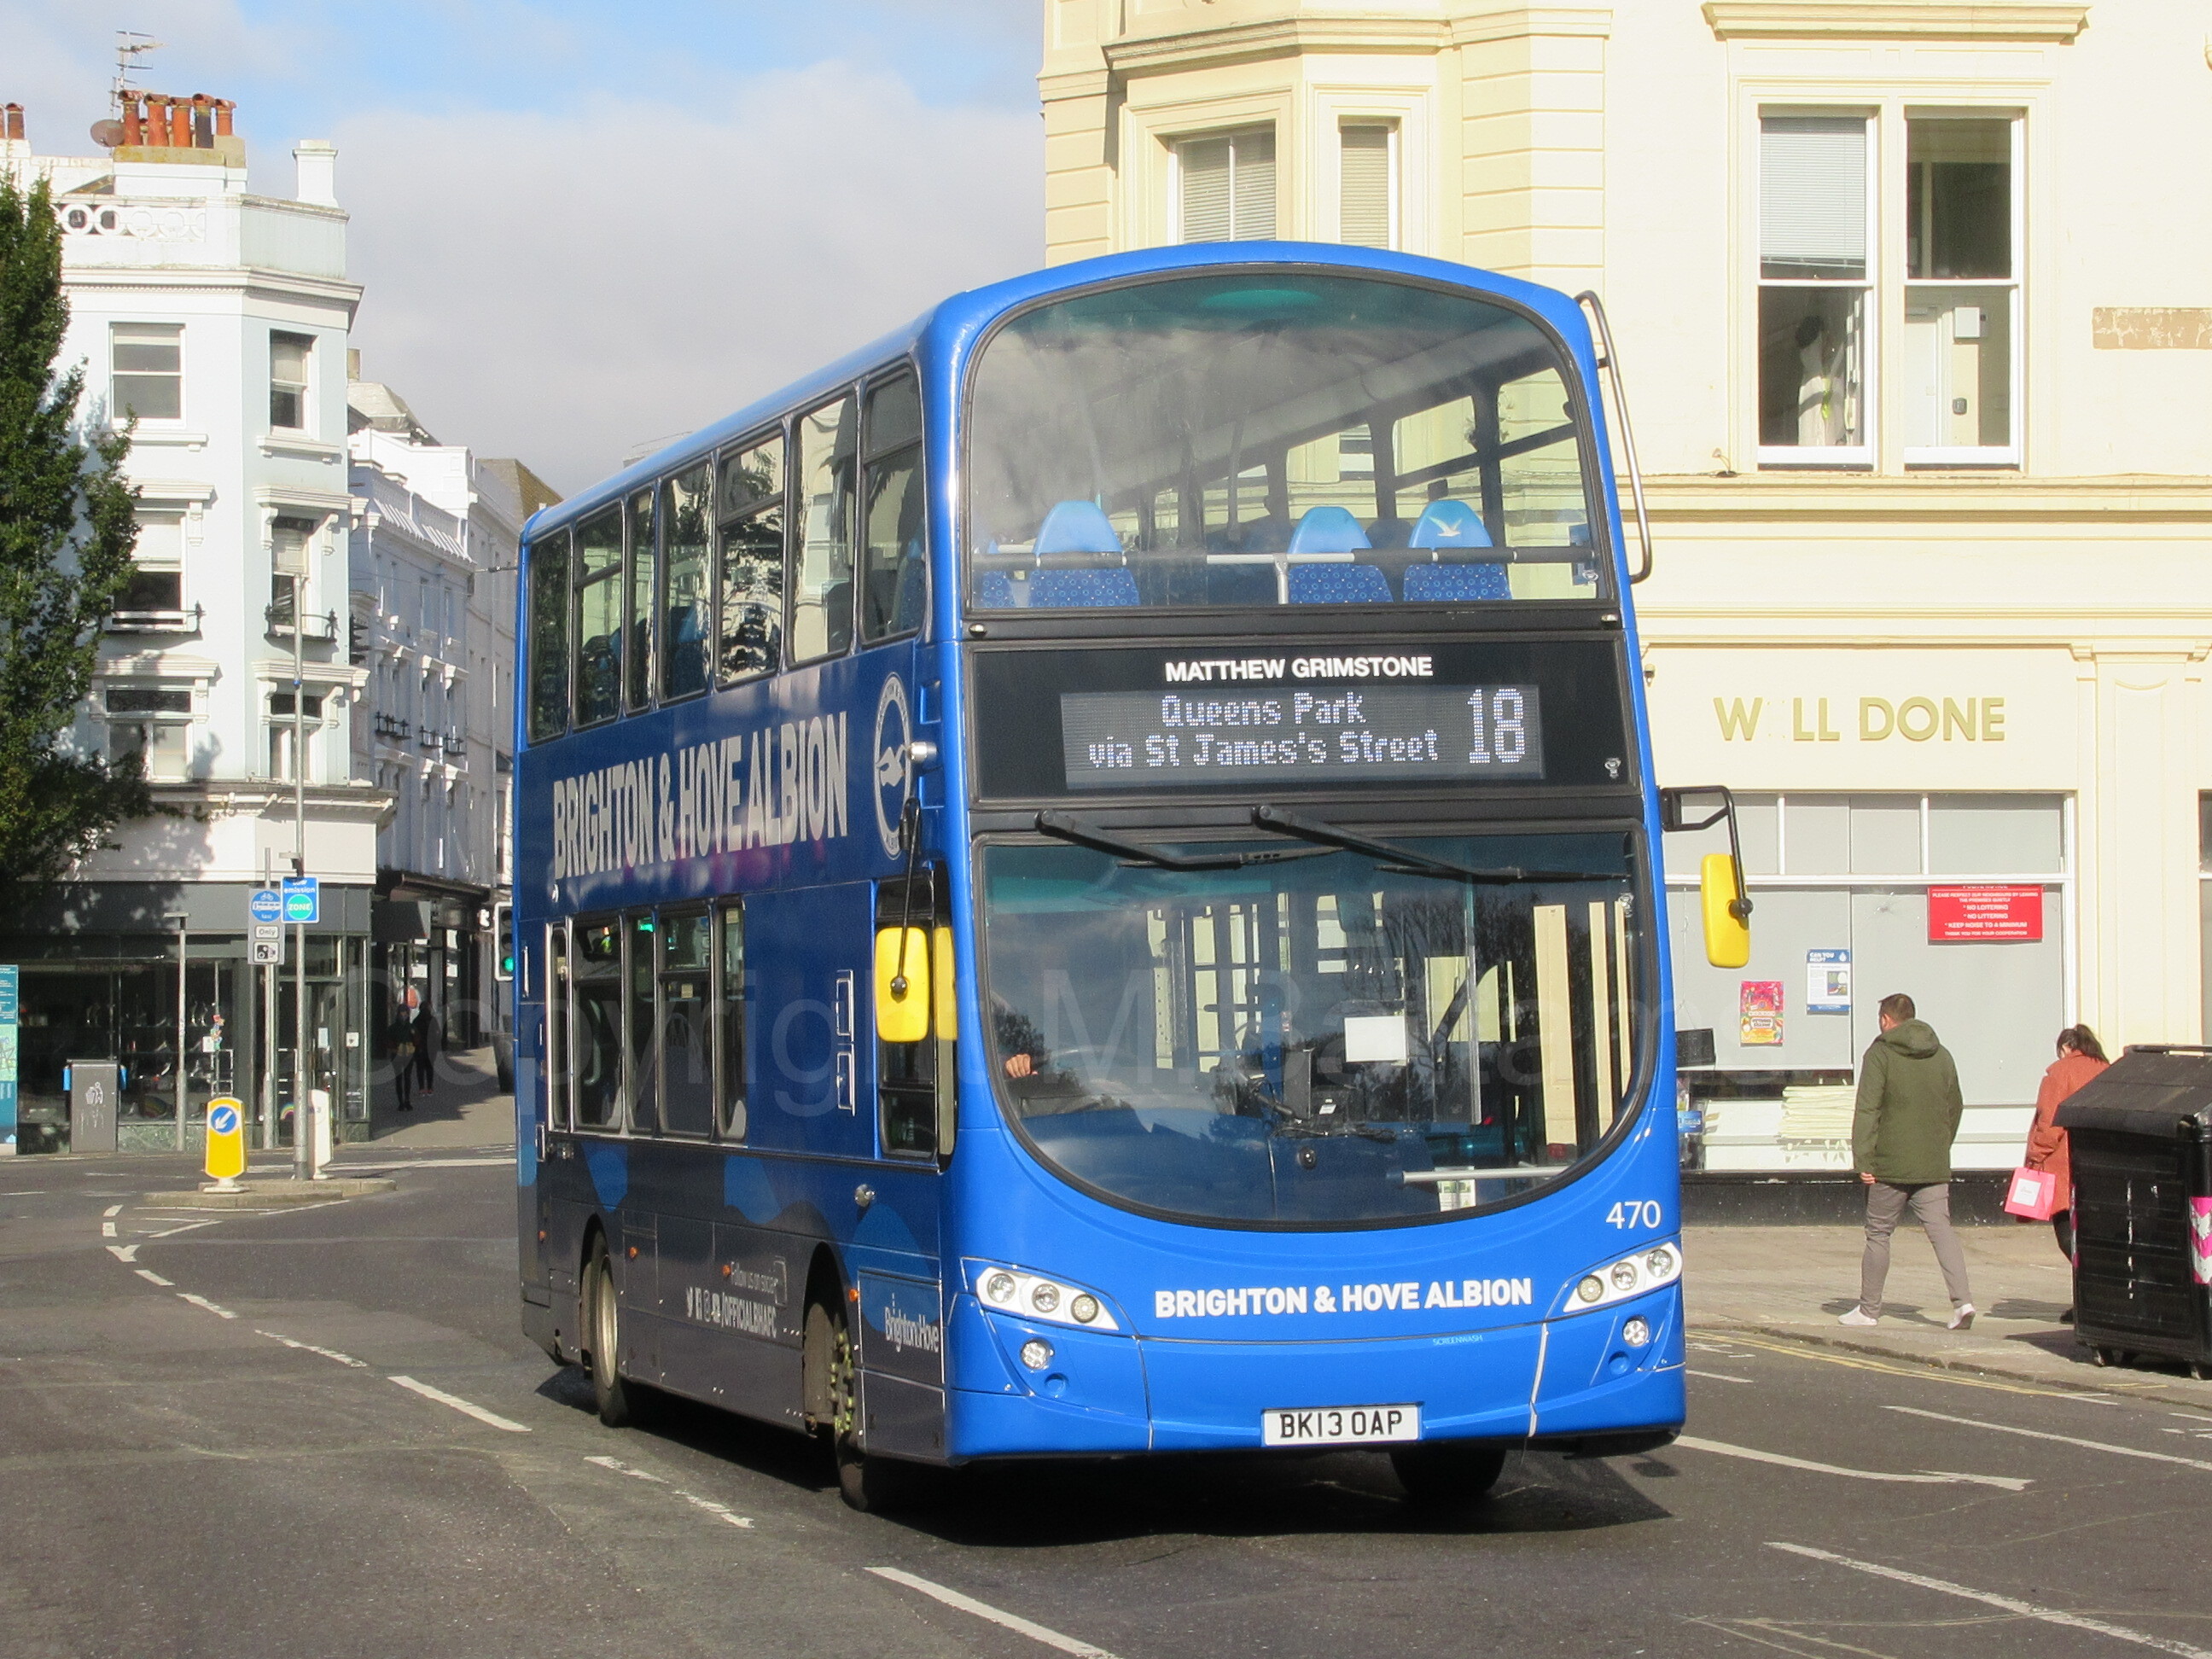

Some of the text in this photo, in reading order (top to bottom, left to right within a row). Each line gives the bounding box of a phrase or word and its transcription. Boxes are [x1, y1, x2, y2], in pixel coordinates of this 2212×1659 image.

[1165, 655, 1434, 682] MATTHEW GRIMSTONE
[1161, 691, 1367, 727] Queens Park
[1859, 696, 2005, 742] DONE
[1467, 688, 1526, 764] 18
[1089, 729, 1439, 768] via St James's Street
[553, 755, 655, 880] BRIGHTON
[659, 752, 675, 863] &
[679, 735, 743, 860] HOVE
[747, 711, 848, 849] ALBION
[288, 903, 311, 911] ZONE
[259, 928, 276, 936] Only
[1605, 1199, 1662, 1230] 470
[1155, 1278, 1533, 1318] BRIGHTON & HOVE ALBION
[1432, 1335, 1484, 1346] SCREENWASH
[1280, 1410, 1403, 1439] BK13 OAP
